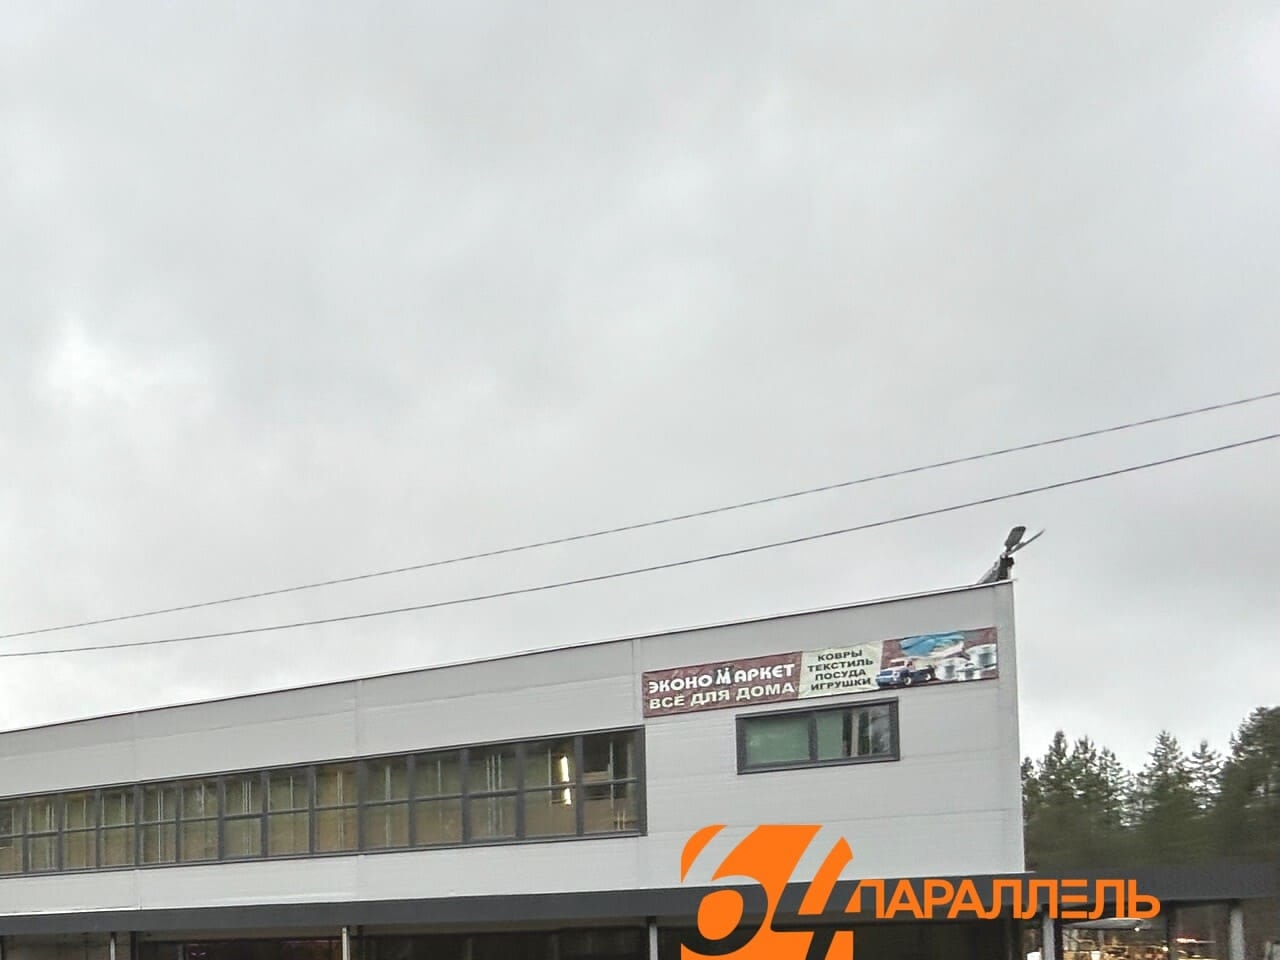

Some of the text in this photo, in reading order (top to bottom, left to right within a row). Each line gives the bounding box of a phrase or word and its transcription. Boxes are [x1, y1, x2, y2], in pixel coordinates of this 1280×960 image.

[817, 649, 863, 662] КОВРЫ
[807, 658, 875, 673] ТЕКСТИЛЬ
[815, 668, 867, 681] ПОСУДА
[809, 677, 872, 692] ИГРУШКИ
[690, 690, 730, 707] ДЛЯ
[735, 682, 796, 702] ДОМА
